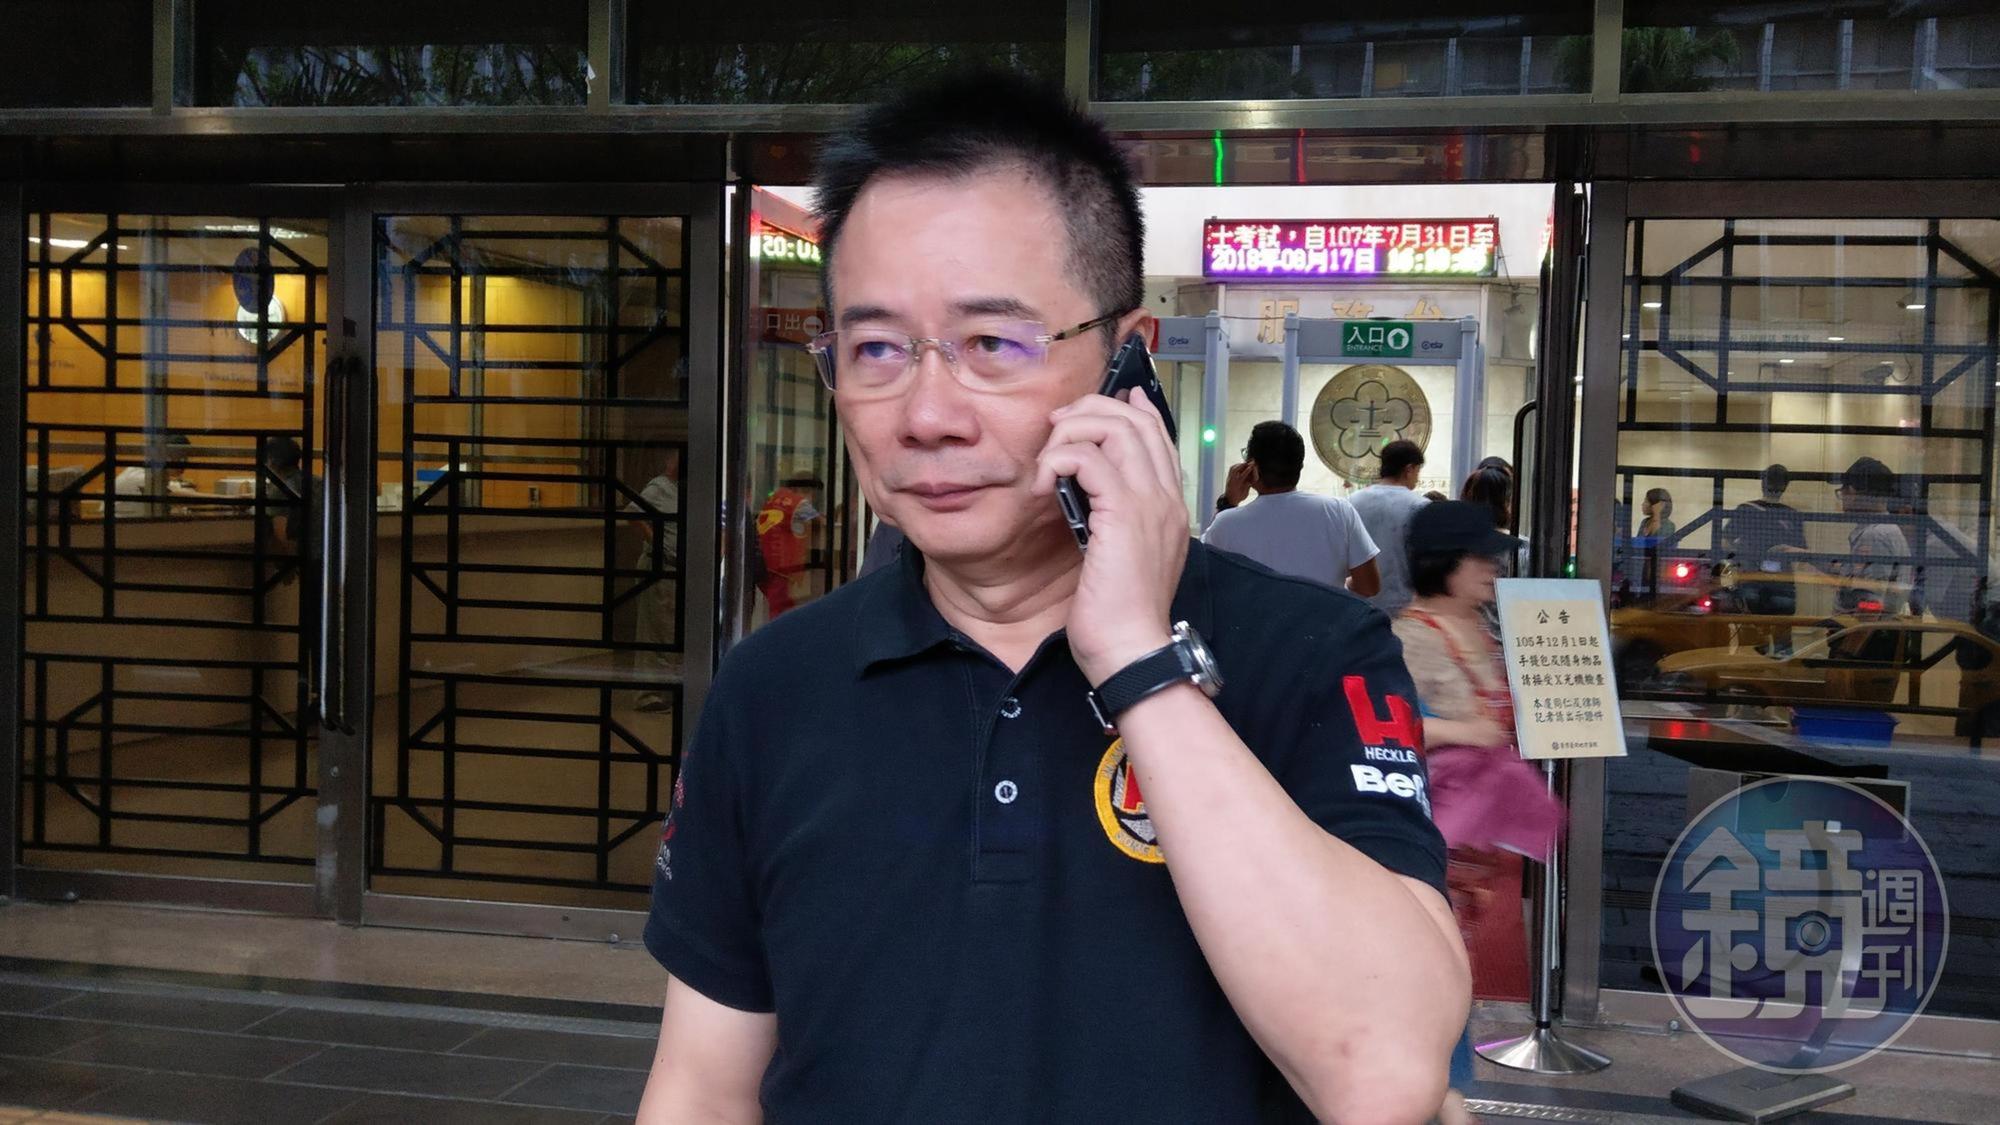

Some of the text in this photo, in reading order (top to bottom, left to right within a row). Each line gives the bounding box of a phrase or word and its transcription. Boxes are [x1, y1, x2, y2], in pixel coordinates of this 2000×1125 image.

[1347, 326, 1384, 344] 入口
[1346, 344, 1383, 352] ENTRANCE
[1537, 609, 1571, 624] 公告
[1515, 635, 1599, 648] 105年12月1日起
